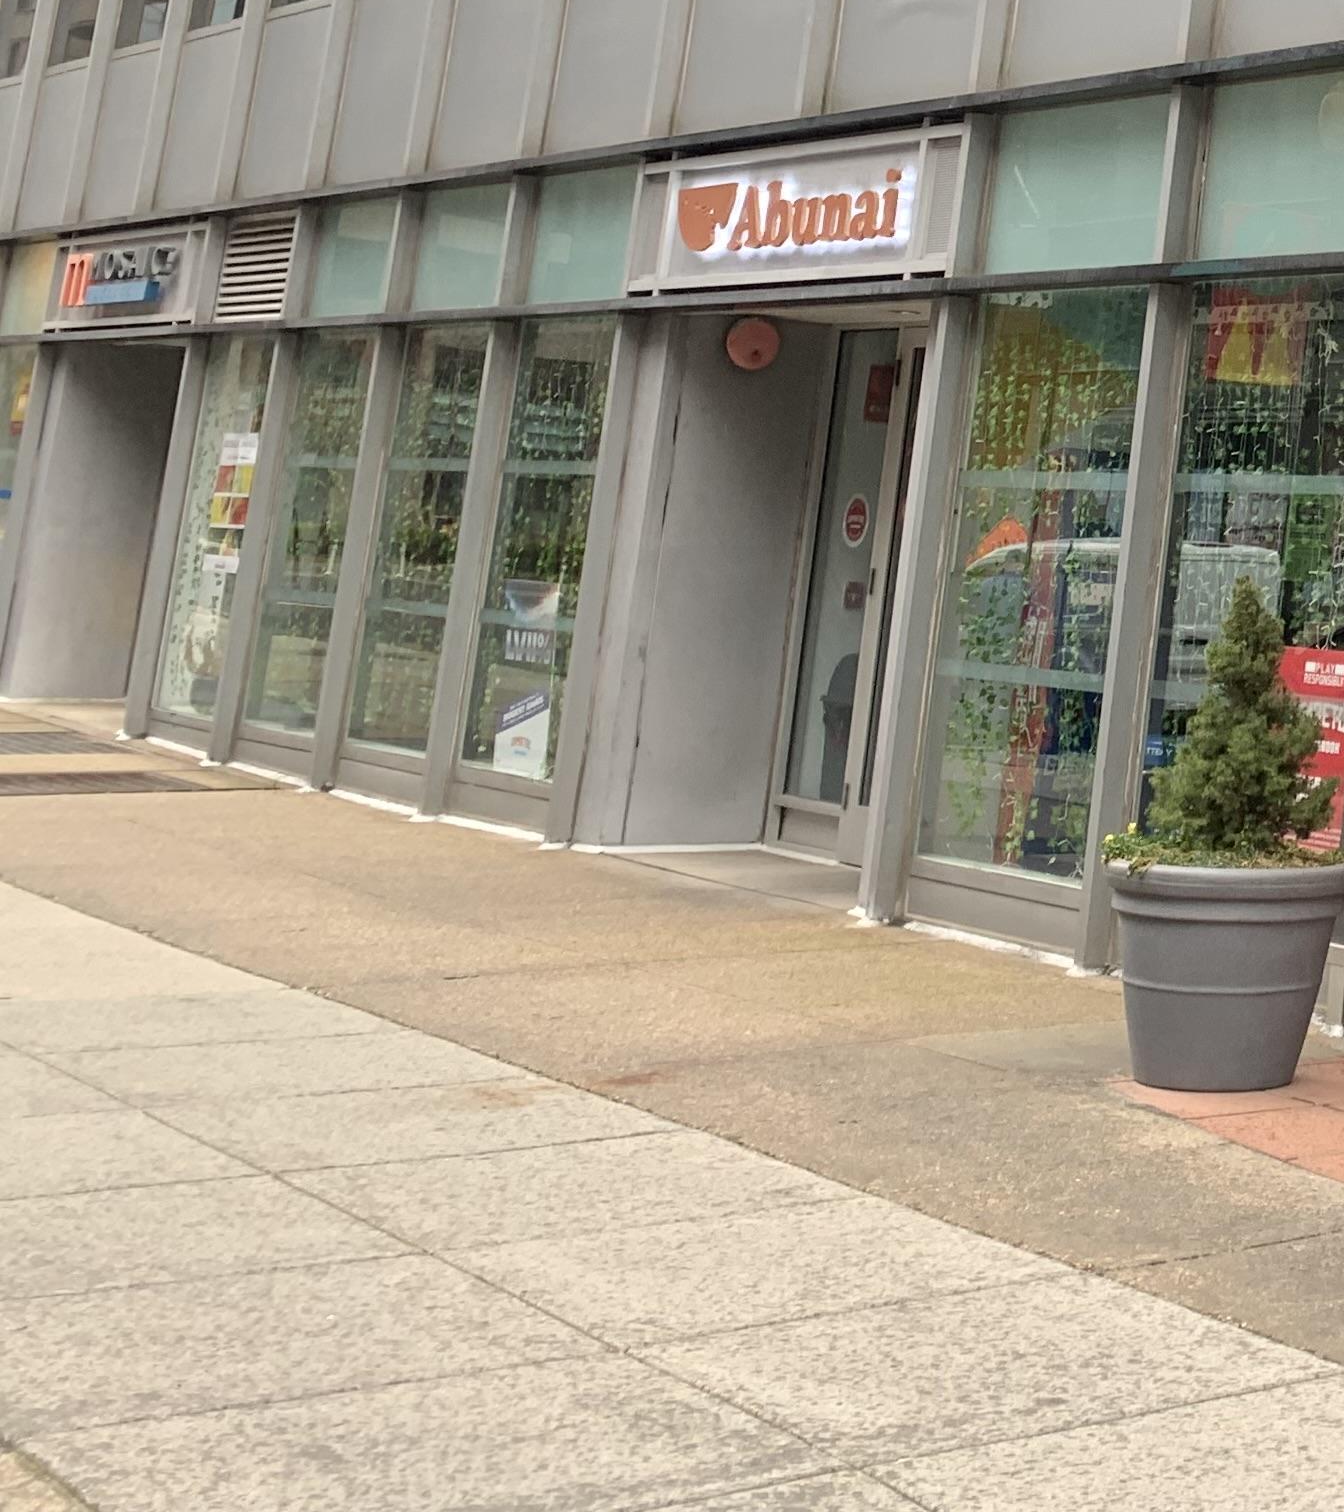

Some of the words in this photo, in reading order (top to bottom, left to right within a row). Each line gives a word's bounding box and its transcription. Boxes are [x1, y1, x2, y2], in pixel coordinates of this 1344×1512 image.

[726, 167, 903, 253] Abunai
[1315, 663, 1336, 675] PLAY
[1303, 673, 1344, 687] RESPONSIBLY
